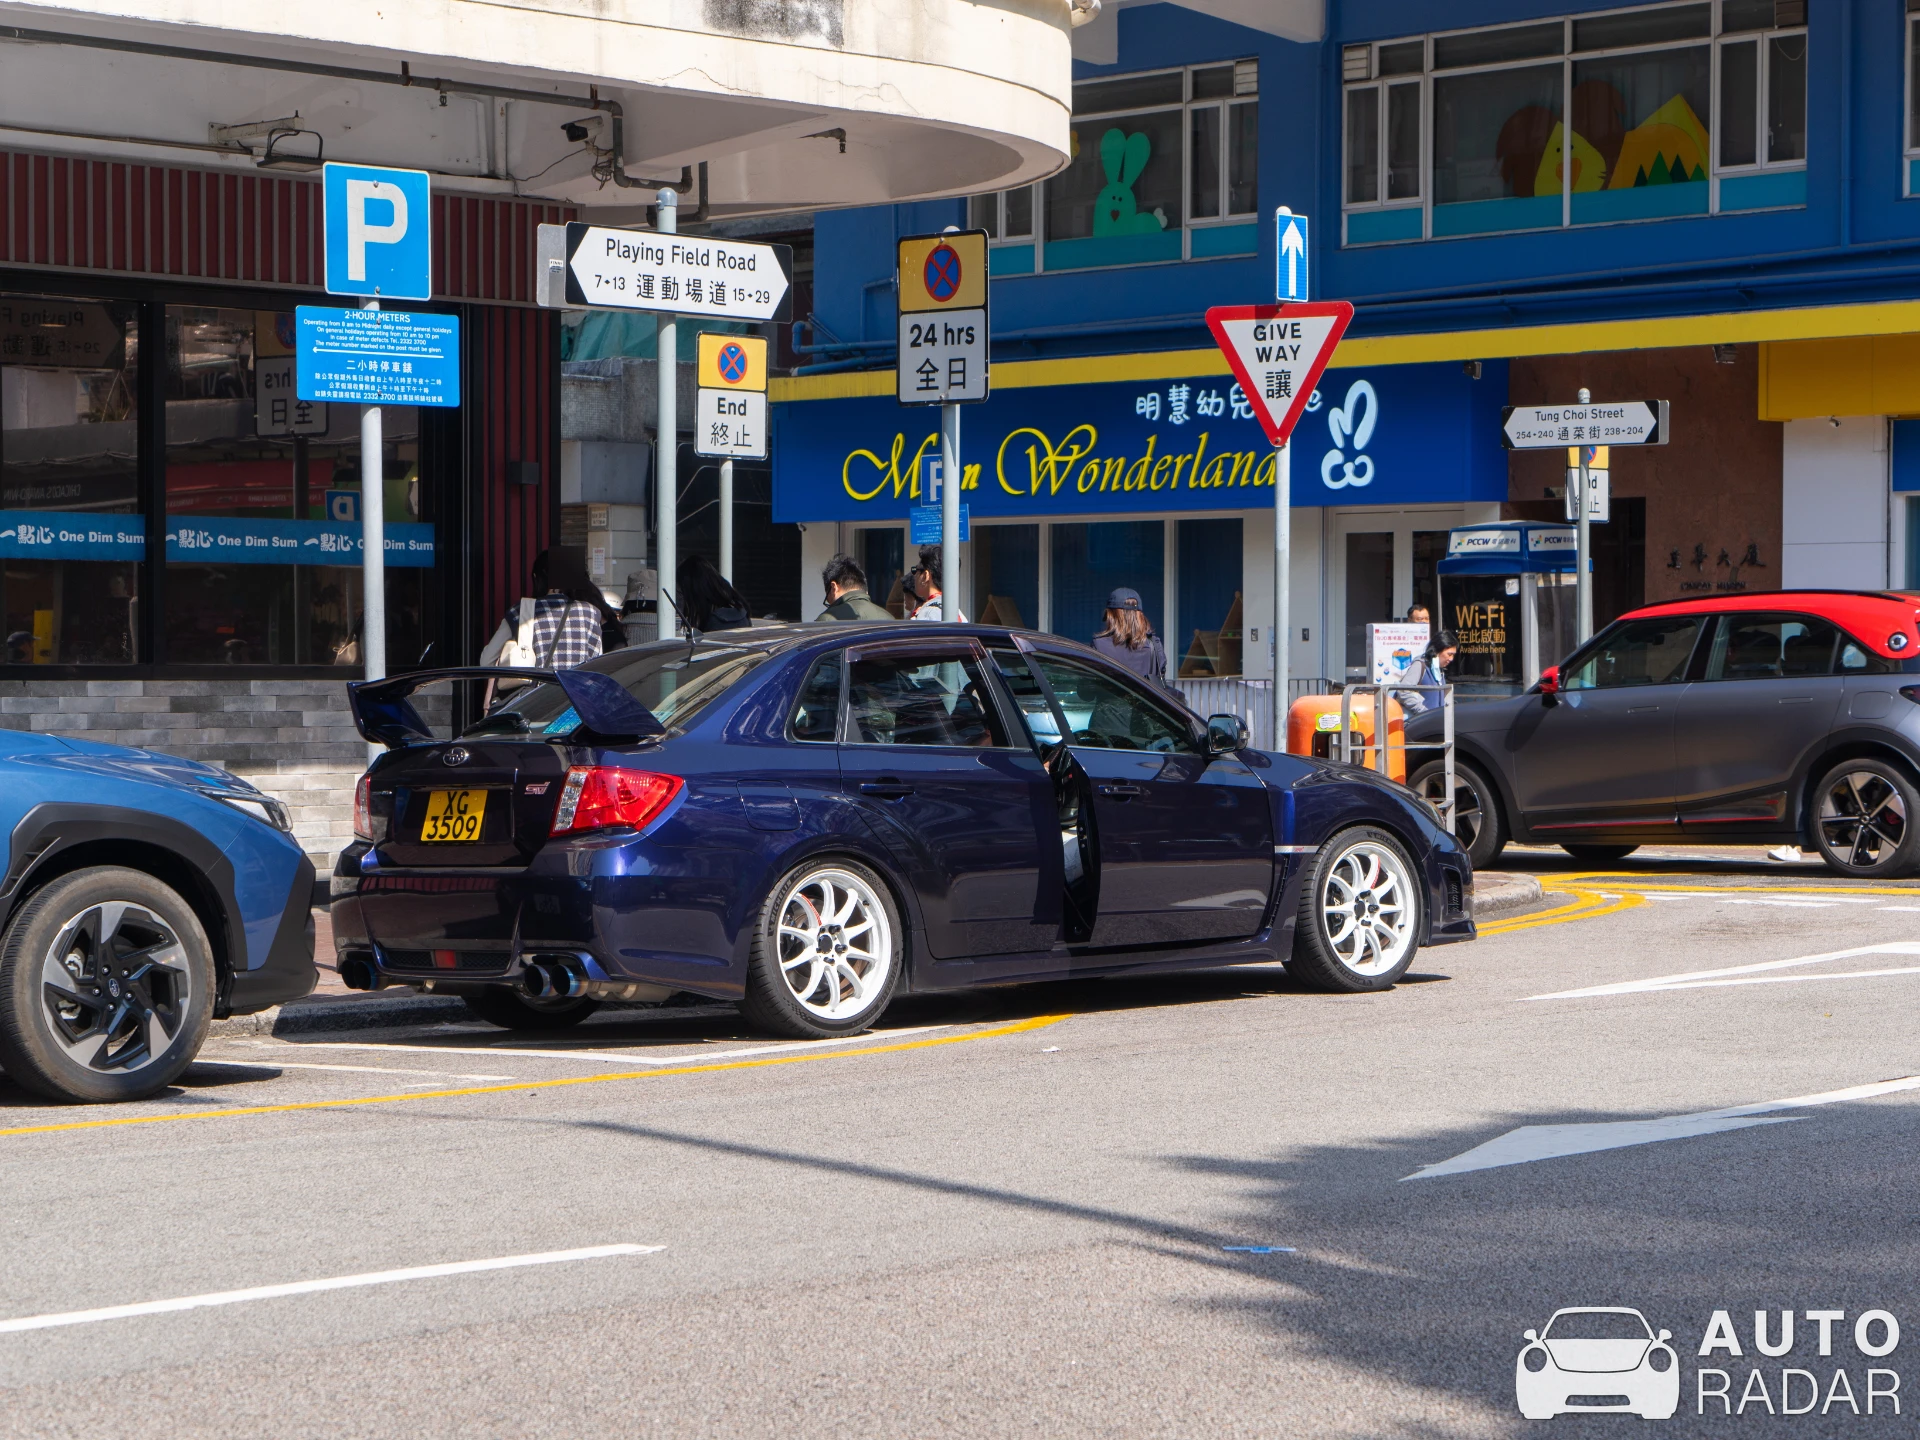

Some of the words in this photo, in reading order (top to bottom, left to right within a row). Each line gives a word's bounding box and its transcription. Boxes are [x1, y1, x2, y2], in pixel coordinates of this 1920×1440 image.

[346, 179, 408, 282] P
[606, 238, 664, 266] Playing
[672, 245, 710, 266] Field
[717, 250, 756, 272] Road
[636, 273, 727, 306] 運動場道
[344, 311, 376, 320] 2-HOUR
[378, 313, 410, 323] METERS
[910, 324, 938, 348] 24
[944, 322, 974, 346] hrs
[1253, 322, 1302, 342] GIVE
[1255, 344, 1302, 363] WAY
[916, 358, 966, 391] 全日
[1266, 369, 1292, 400] 讓
[718, 397, 746, 416] End
[1535, 411, 1559, 422] Tung
[1563, 409, 1587, 420] Choi
[1591, 408, 1624, 419] Street
[711, 422, 752, 447] 終止
[1557, 425, 1601, 441] 通菜街
[0, 524, 55, 544] 一點心
[59, 531, 84, 542] One
[88, 532, 113, 543] Dim
[117, 532, 145, 544] Sum
[166, 529, 214, 548] 一點心
[218, 535, 241, 546] One
[245, 536, 268, 547] Dim
[272, 536, 298, 548] Sum
[304, 533, 354, 552] 一點心
[383, 540, 405, 550] Dim
[408, 540, 433, 550] Sum
[1455, 605, 1505, 628] Wi-Fi
[1458, 630, 1506, 644] 在此啟動
[1460, 645, 1489, 654] Available
[1490, 646, 1506, 654] here
[443, 791, 469, 815] XG
[426, 816, 477, 839] 3509
